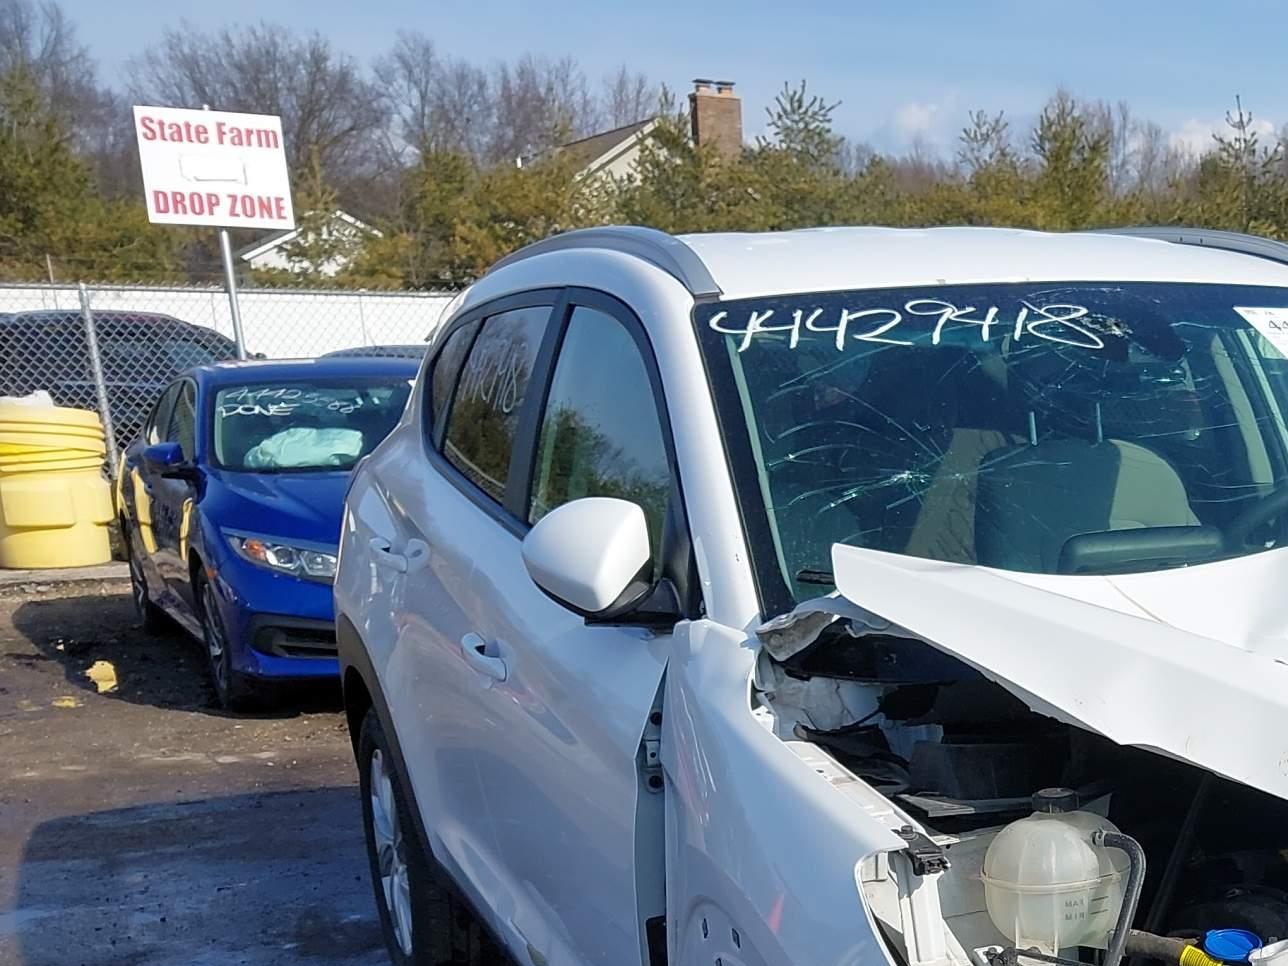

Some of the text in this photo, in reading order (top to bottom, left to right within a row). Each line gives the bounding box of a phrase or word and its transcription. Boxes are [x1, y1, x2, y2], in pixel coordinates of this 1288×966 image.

[140, 116, 279, 149] State Farm
[152, 190, 288, 220] DROP ZONE
[709, 300, 1105, 352] 44429418
[218, 402, 299, 417] DONE
